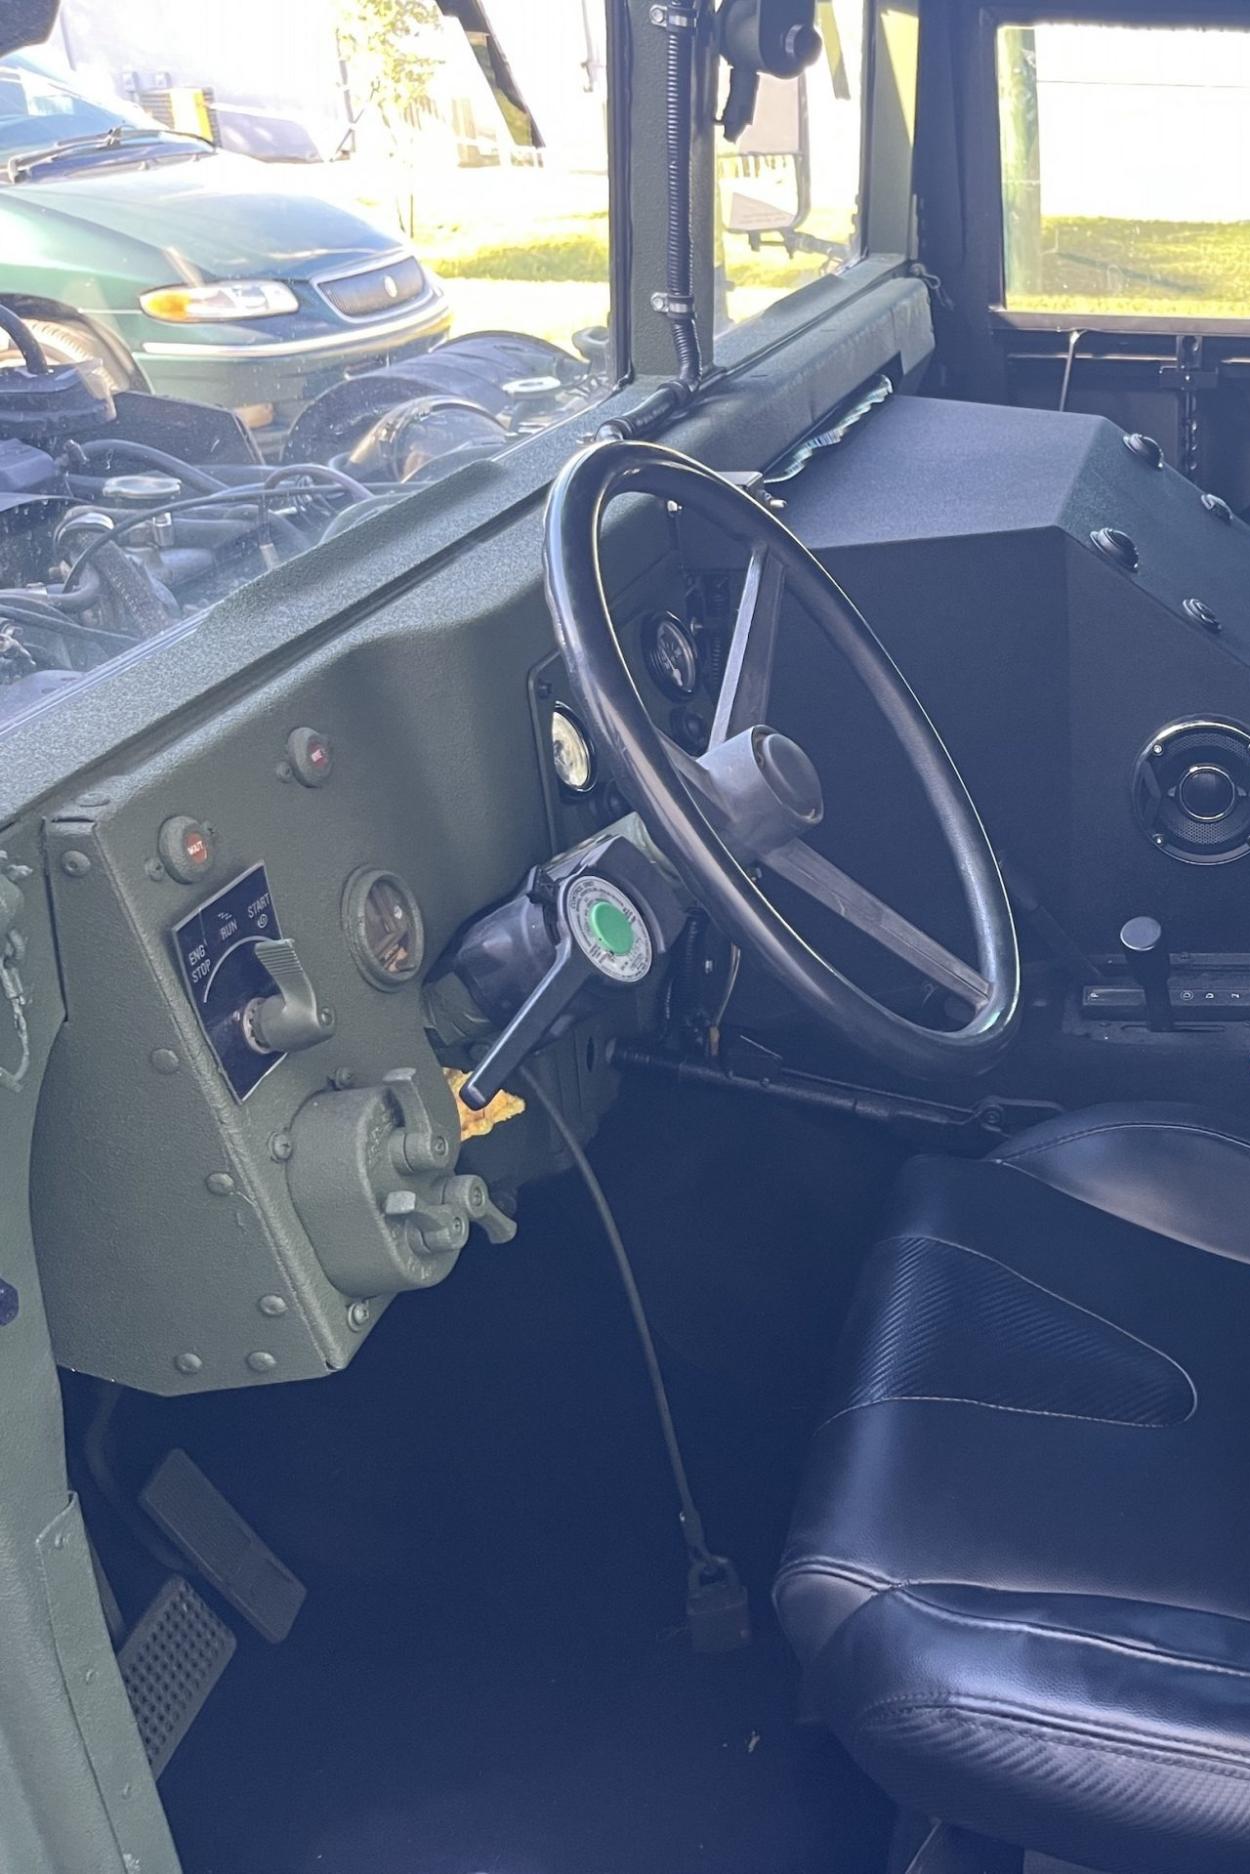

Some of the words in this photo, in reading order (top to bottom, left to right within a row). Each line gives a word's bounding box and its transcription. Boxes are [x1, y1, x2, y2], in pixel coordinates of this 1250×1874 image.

[247, 892, 270, 918] START
[219, 919, 238, 940] RUN
[188, 944, 206, 965] ENG
[191, 958, 211, 983] STOP
